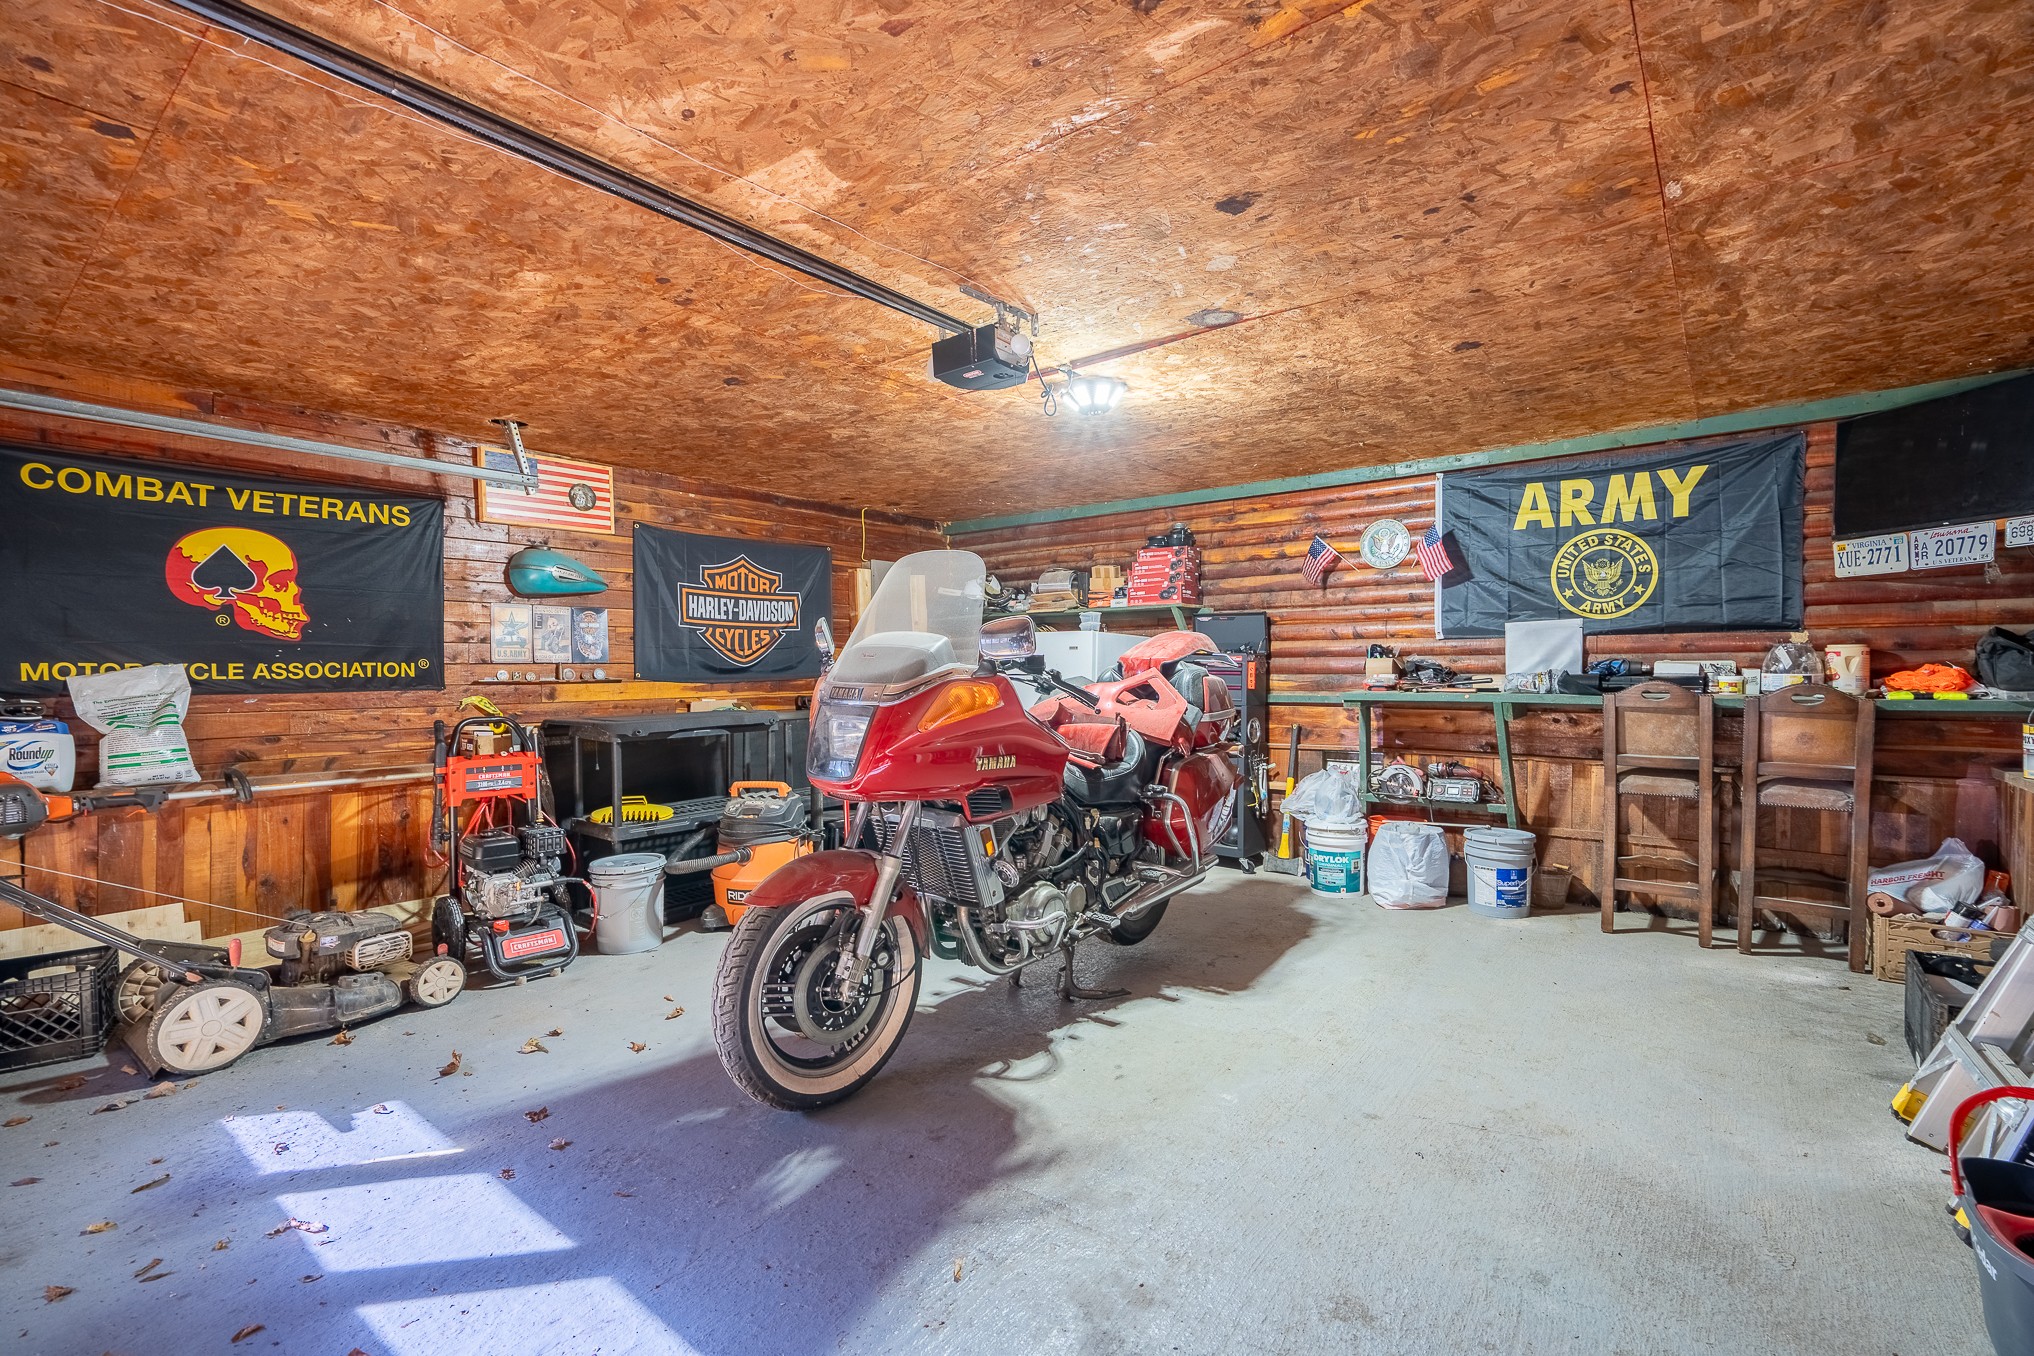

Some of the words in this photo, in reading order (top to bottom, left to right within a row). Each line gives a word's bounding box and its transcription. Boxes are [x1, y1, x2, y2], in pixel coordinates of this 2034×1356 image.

[20, 462, 215, 507] COMBAT
[226, 487, 411, 527] VETERANS
[1513, 465, 1710, 530] ARMY
[1852, 539, 1887, 549] VIRGINIA
[1935, 534, 1988, 557] 20779
[1557, 535, 1599, 578] UNITED
[1604, 534, 1652, 573] STATES
[1837, 545, 1902, 569] XUE-2771
[715, 567, 770, 593] MOTOR
[688, 594, 794, 623] HARLEY-DAVIDSON
[1579, 597, 1626, 614] ARMY
[715, 628, 771, 656] CYCLES
[20, 662, 244, 681] MOTOCLE
[830, 687, 860, 700] YAMAHA
[9, 747, 54, 762] Roundup
[975, 755, 1017, 771] YAMAHA
[1313, 854, 1349, 864] DRYLOK
[1870, 875, 1906, 885] HARBOR
[513, 936, 554, 951] CRAFTSMAN
